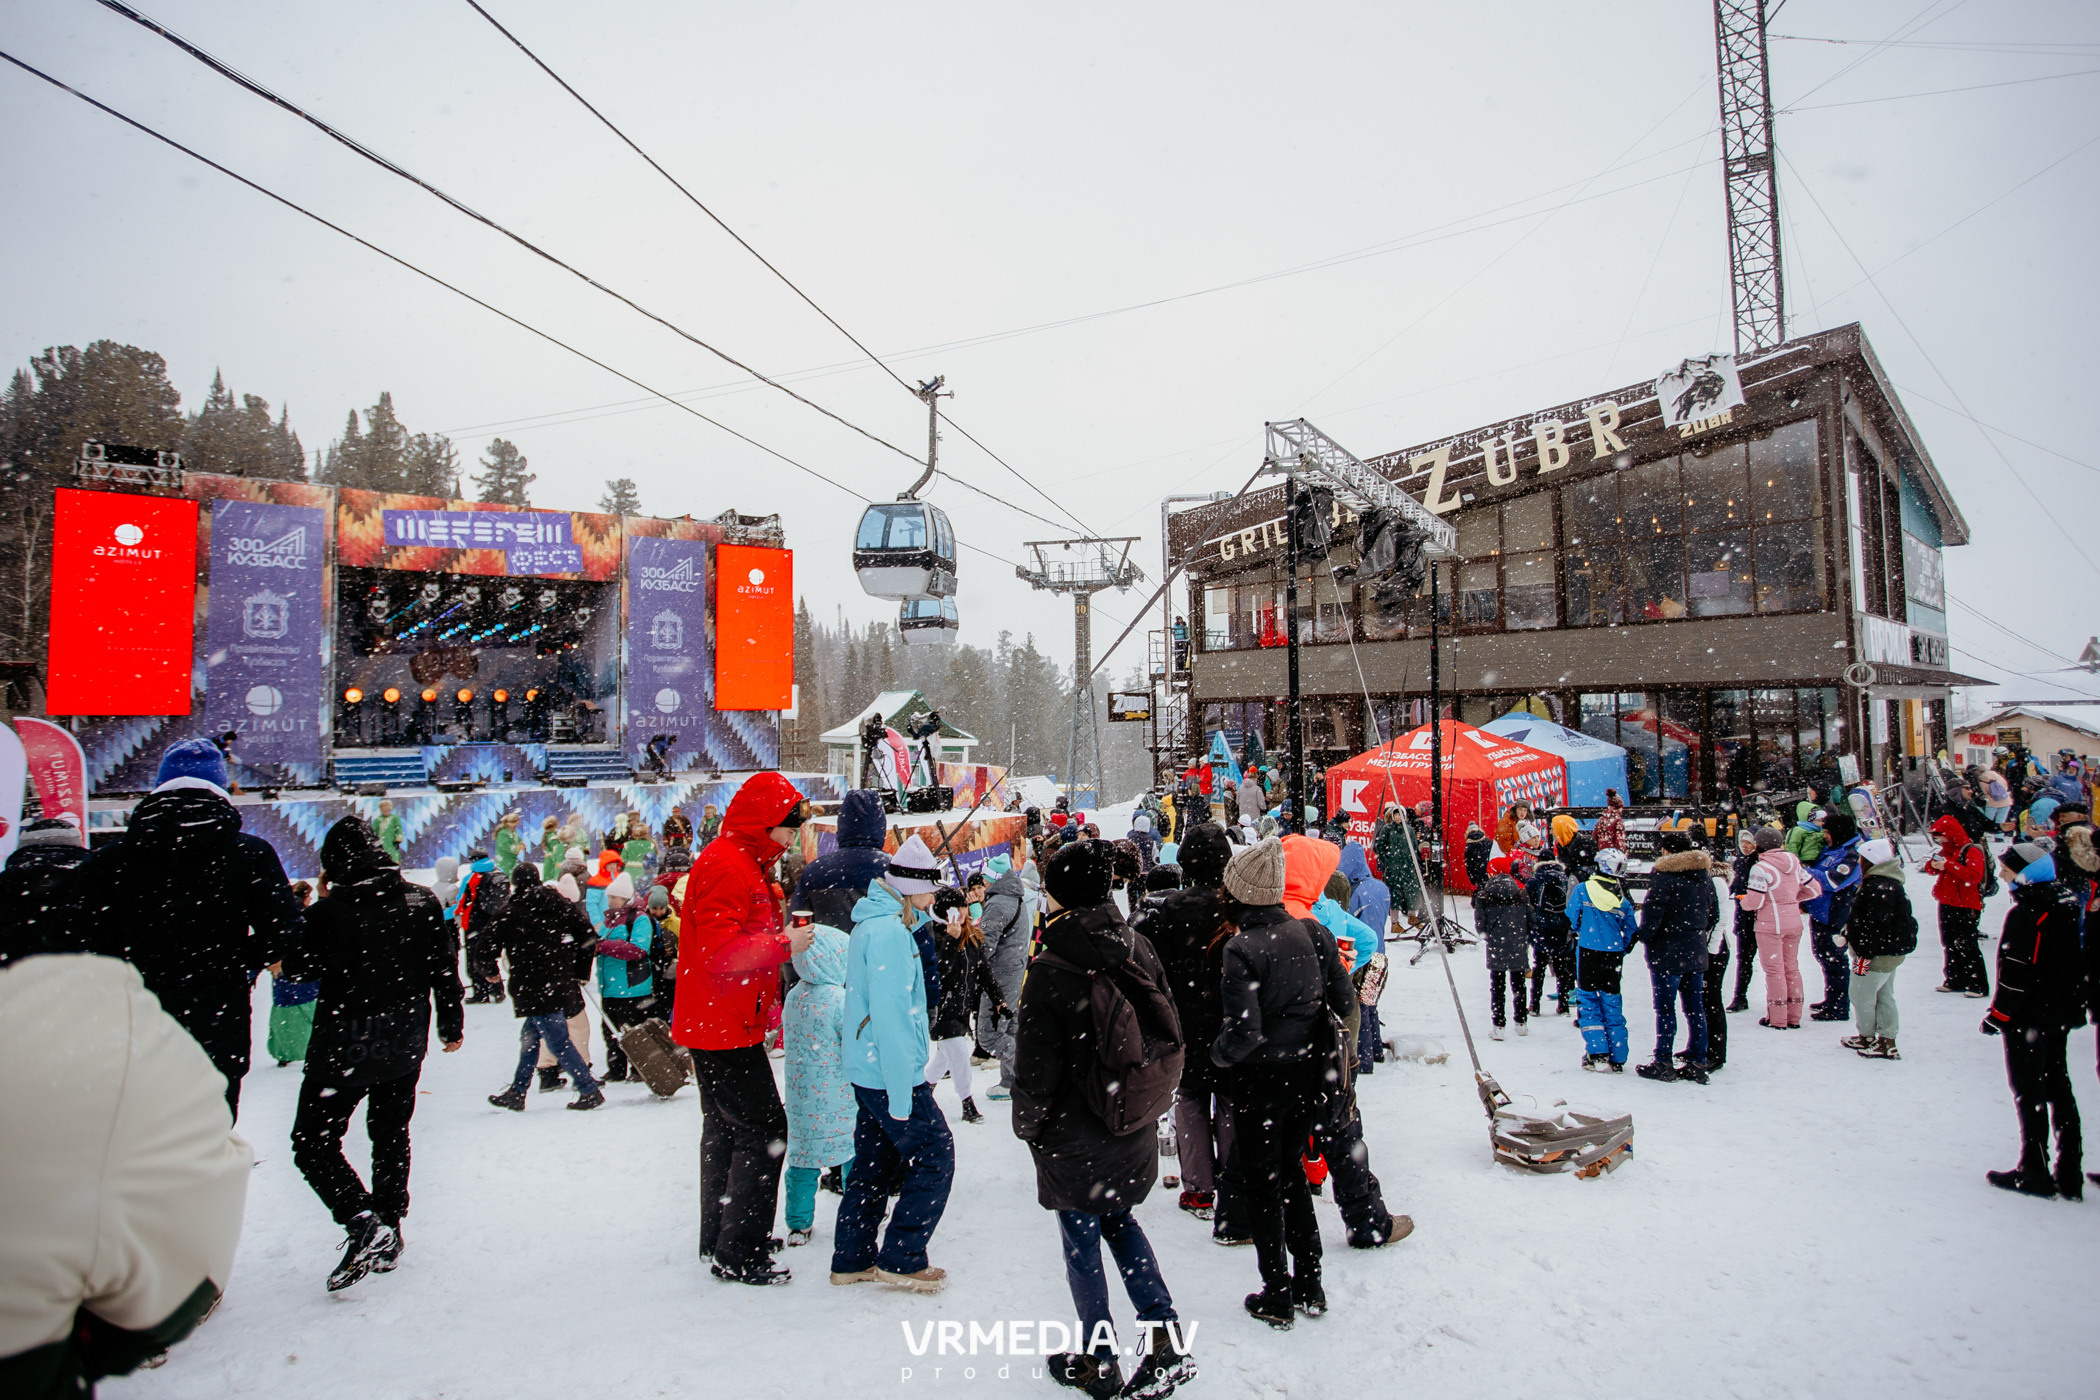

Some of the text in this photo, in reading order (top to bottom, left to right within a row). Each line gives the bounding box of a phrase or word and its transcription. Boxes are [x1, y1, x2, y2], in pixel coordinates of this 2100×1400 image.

[1679, 410, 1734, 438] ZUBR
[1409, 401, 1628, 516] ZUBR
[228, 537, 265, 552] 300
[1219, 520, 1289, 561] GRIL
[227, 552, 307, 570] КУЗБАСС
[641, 567, 664, 579] 300
[640, 579, 696, 593] КУЗБАСС
[1075, 604, 1087, 614] 10
[1868, 617, 1912, 667] ПРОКАТ
[1379, 751, 1456, 762] КУЗБАССАЯ
[1367, 758, 1455, 770] МЕДИА ГРУПА
[1349, 820, 1376, 833] УЗБА
